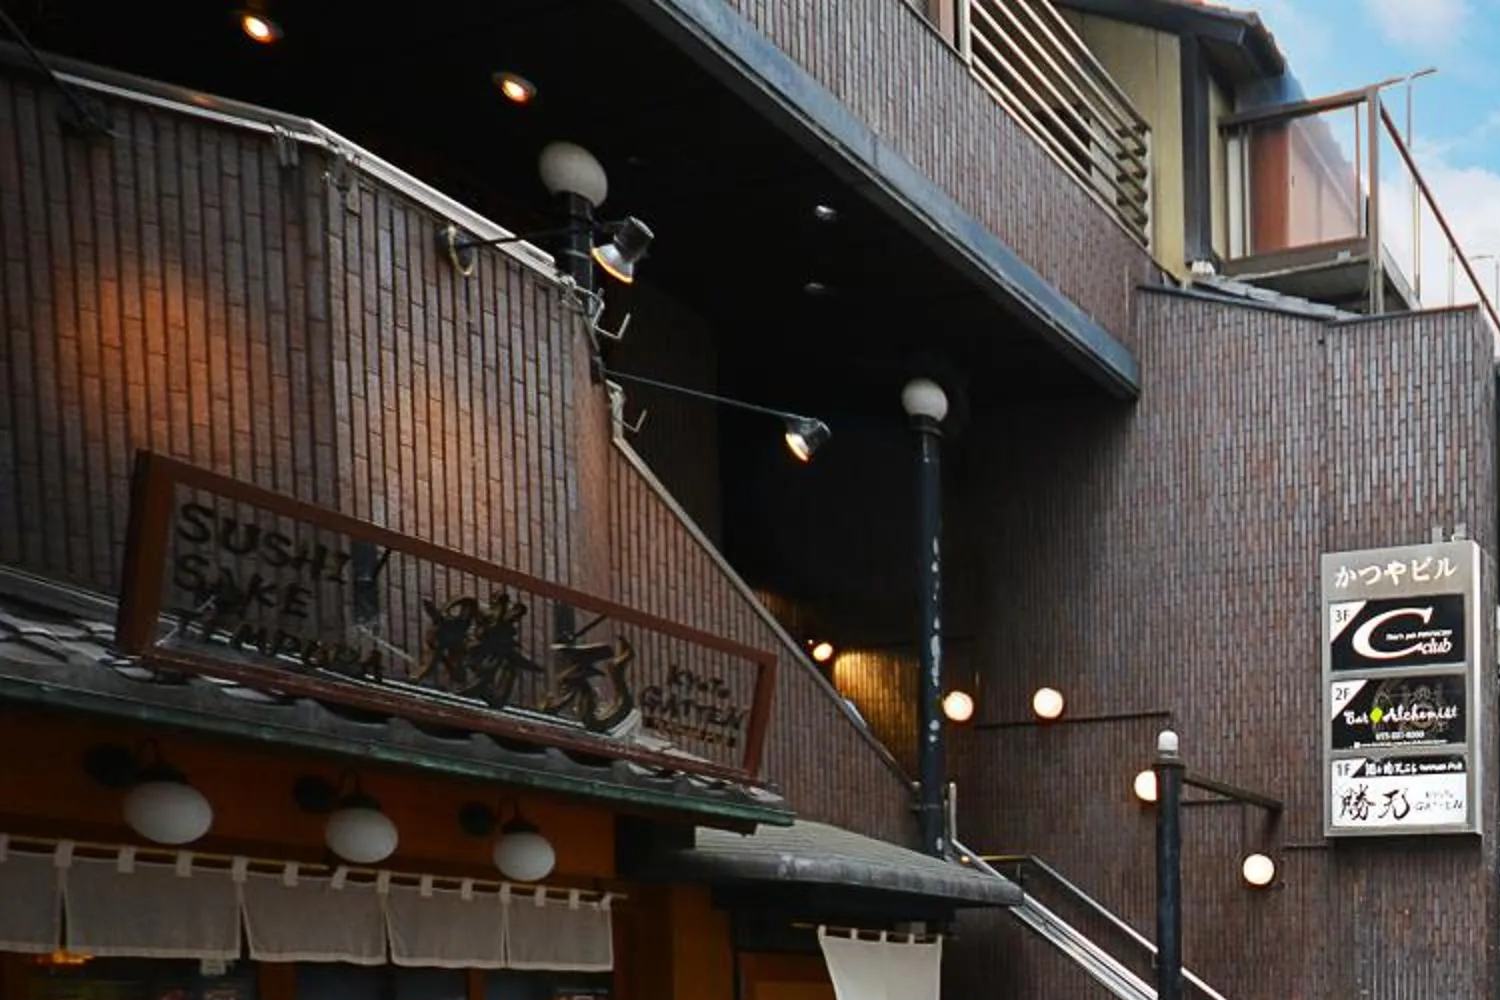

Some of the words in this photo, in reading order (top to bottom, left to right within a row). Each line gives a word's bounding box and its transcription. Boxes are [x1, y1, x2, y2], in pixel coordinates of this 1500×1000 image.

[177, 502, 352, 585] SUSHI
[1334, 556, 1457, 589] かつやビル
[173, 553, 313, 619] SAKE
[1334, 608, 1350, 624] 3F
[1334, 687, 1350, 702] 2F
[1336, 763, 1350, 777] 1F
